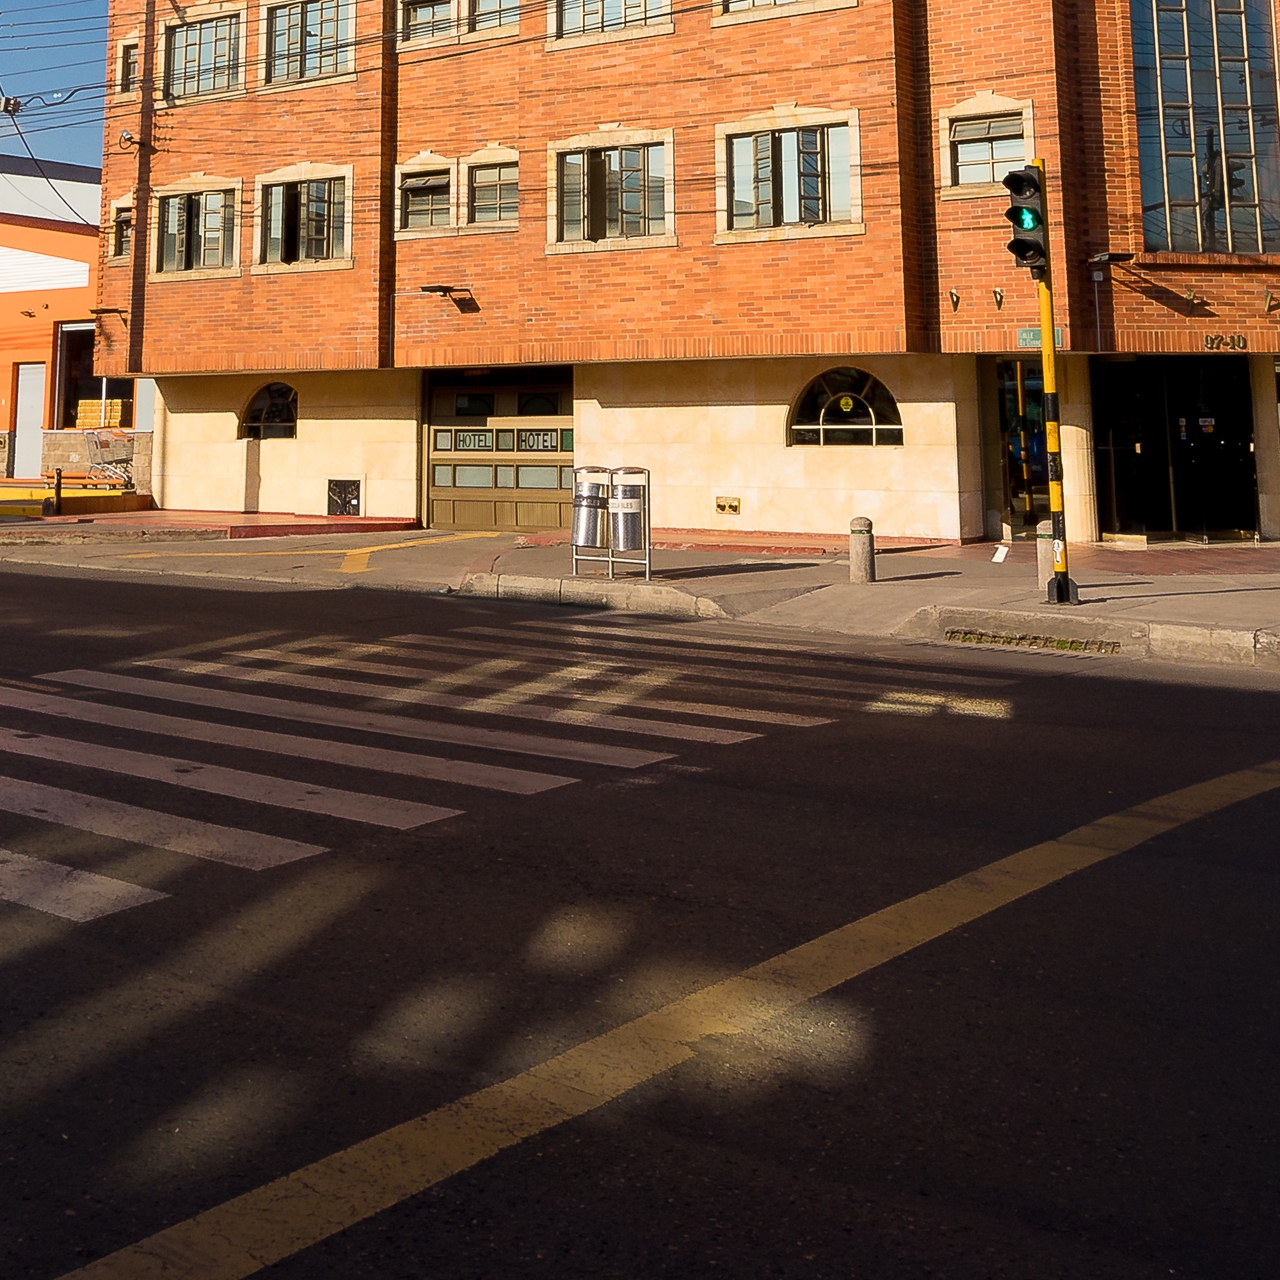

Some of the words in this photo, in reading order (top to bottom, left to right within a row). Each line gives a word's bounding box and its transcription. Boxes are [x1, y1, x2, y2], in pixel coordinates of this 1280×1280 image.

[1205, 334, 1247, 350] 97-10
[458, 434, 492, 448] HOTEL
[520, 432, 557, 449] HOTEL
